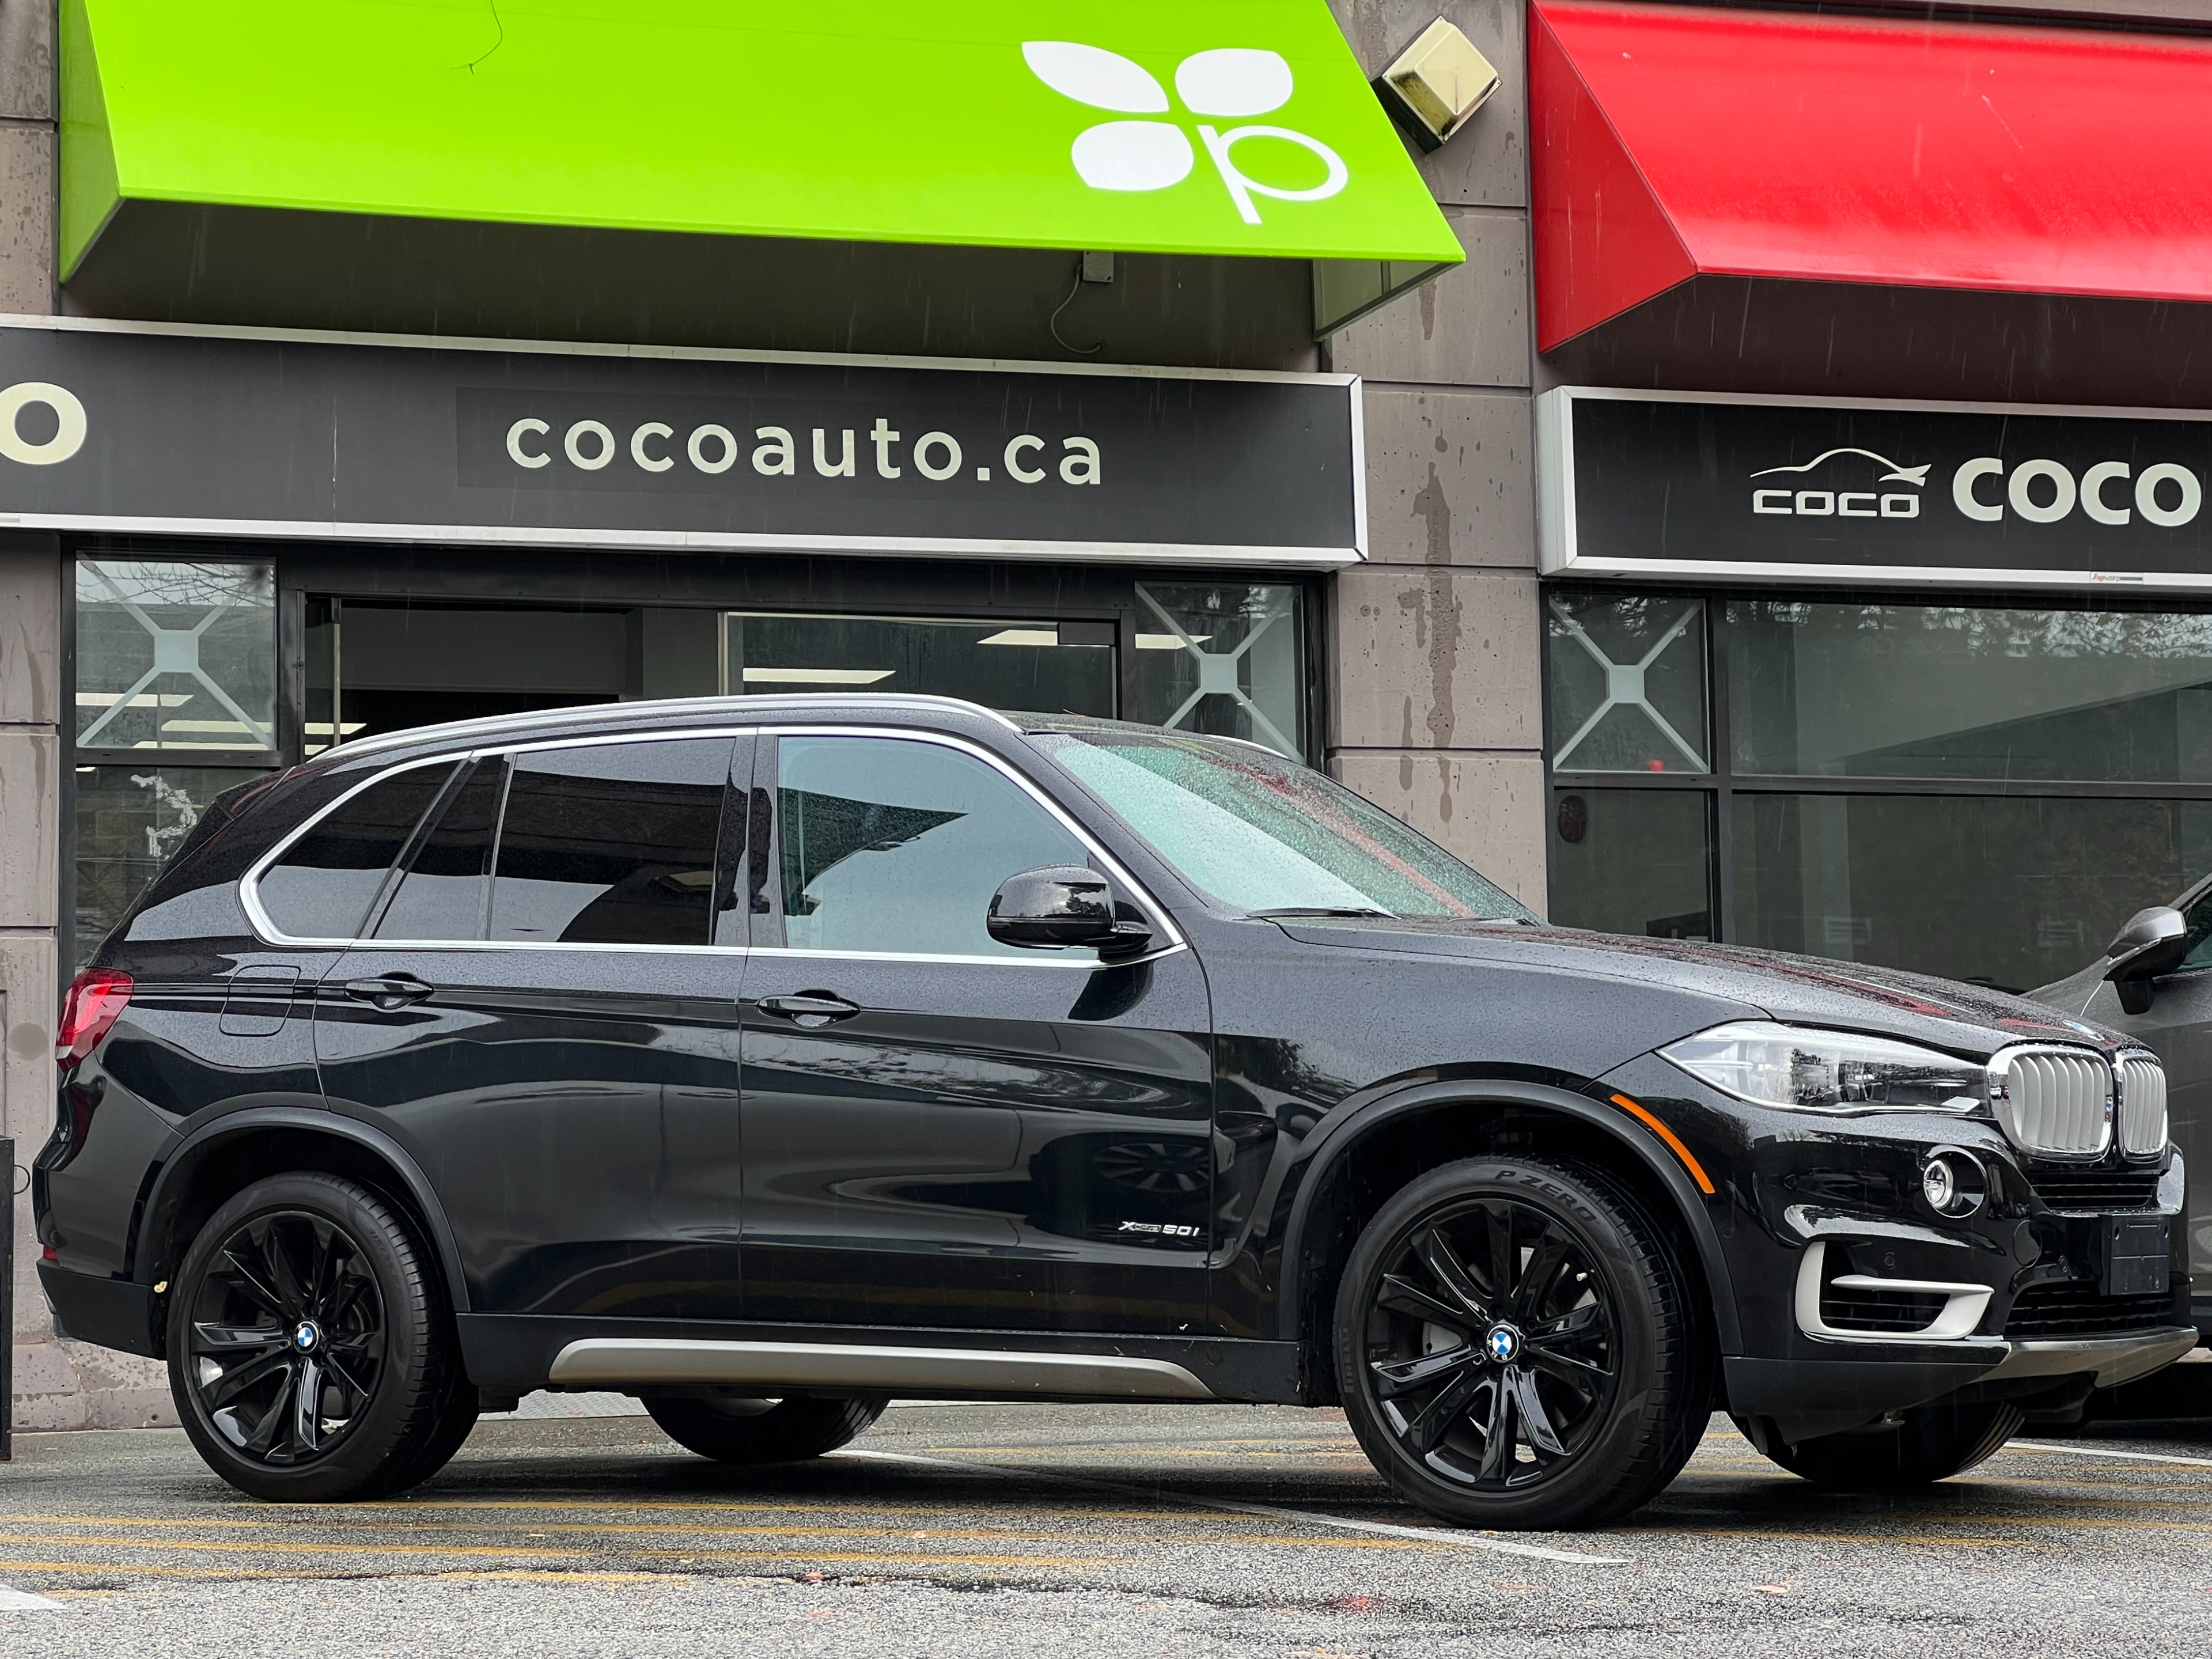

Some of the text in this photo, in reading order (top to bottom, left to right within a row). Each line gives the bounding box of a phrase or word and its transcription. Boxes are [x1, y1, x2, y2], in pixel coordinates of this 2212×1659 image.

[506, 418, 1101, 485] cocoauto.ca
[1753, 489, 1919, 518] COCO
[1952, 457, 2202, 527] COCO
[1494, 1169, 1597, 1222] P ZERO
[1338, 1327, 1355, 1393] PIRELLI
[1486, 1339, 1508, 1361] BMW
